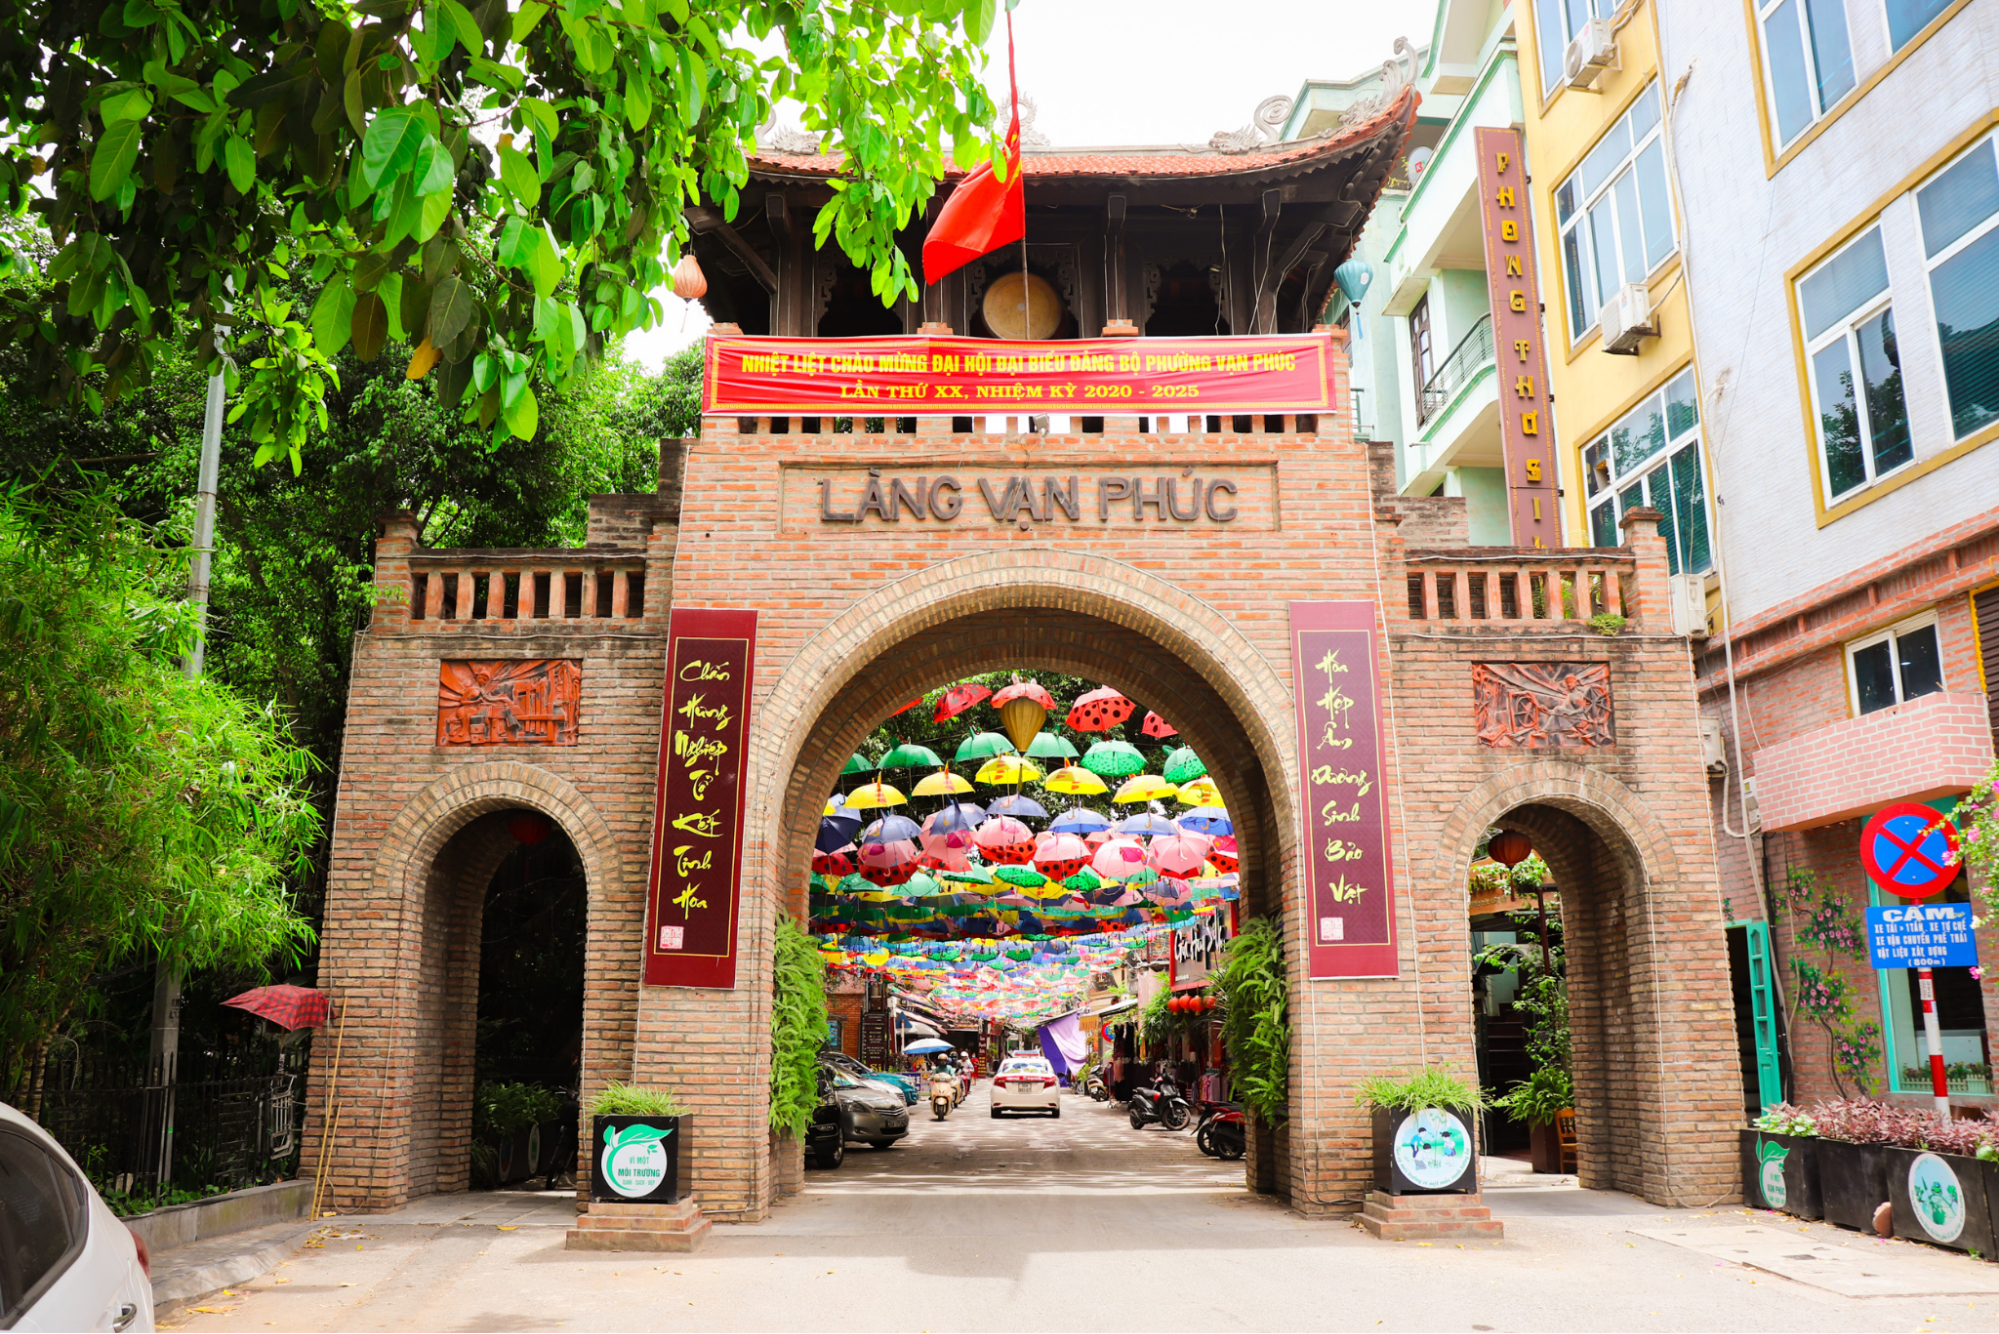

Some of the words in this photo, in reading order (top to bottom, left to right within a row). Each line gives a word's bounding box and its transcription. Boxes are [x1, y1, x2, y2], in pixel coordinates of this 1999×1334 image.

[742, 351, 789, 377] NHIỆT
[793, 351, 824, 377] LIỆT
[831, 351, 874, 373] CHÀO
[878, 351, 928, 373] MỪNG
[932, 354, 961, 377] ĐẠI
[964, 352, 993, 377] HỘI
[996, 355, 1023, 377] ĐẠI
[1029, 350, 1065, 372] BIỂU
[1069, 350, 1114, 372] ĐẢNG
[1119, 351, 1141, 376] BỘ
[1146, 350, 1212, 372] PHƯỜNG
[1216, 353, 1249, 376] VẠN
[1252, 350, 1296, 372] PHÚC
[840, 380, 879, 398] LẦN
[886, 382, 929, 398] THỨ
[934, 385, 969, 400] XX,
[976, 382, 1043, 401] NHIỆM
[1049, 381, 1078, 398] KỲ
[1084, 384, 1132, 398] 2020
[1151, 384, 1200, 398] 2025
[821, 467, 962, 522] LÀNG
[977, 475, 1080, 532] VẠN
[1100, 466, 1238, 522] PHÚC
[1321, 800, 1361, 827] Sinh
[673, 845, 712, 878] Tinh
[1324, 837, 1364, 862] Bảo
[1328, 872, 1369, 905] Vật
[1882, 904, 1955, 922] CẤM
[1874, 924, 1884, 934] XE
[1929, 922, 1939, 932] XE
[1875, 936, 1886, 946] XE
[618, 1167, 631, 1176] MÔI
[633, 1167, 660, 1177] TRƯỜNG
